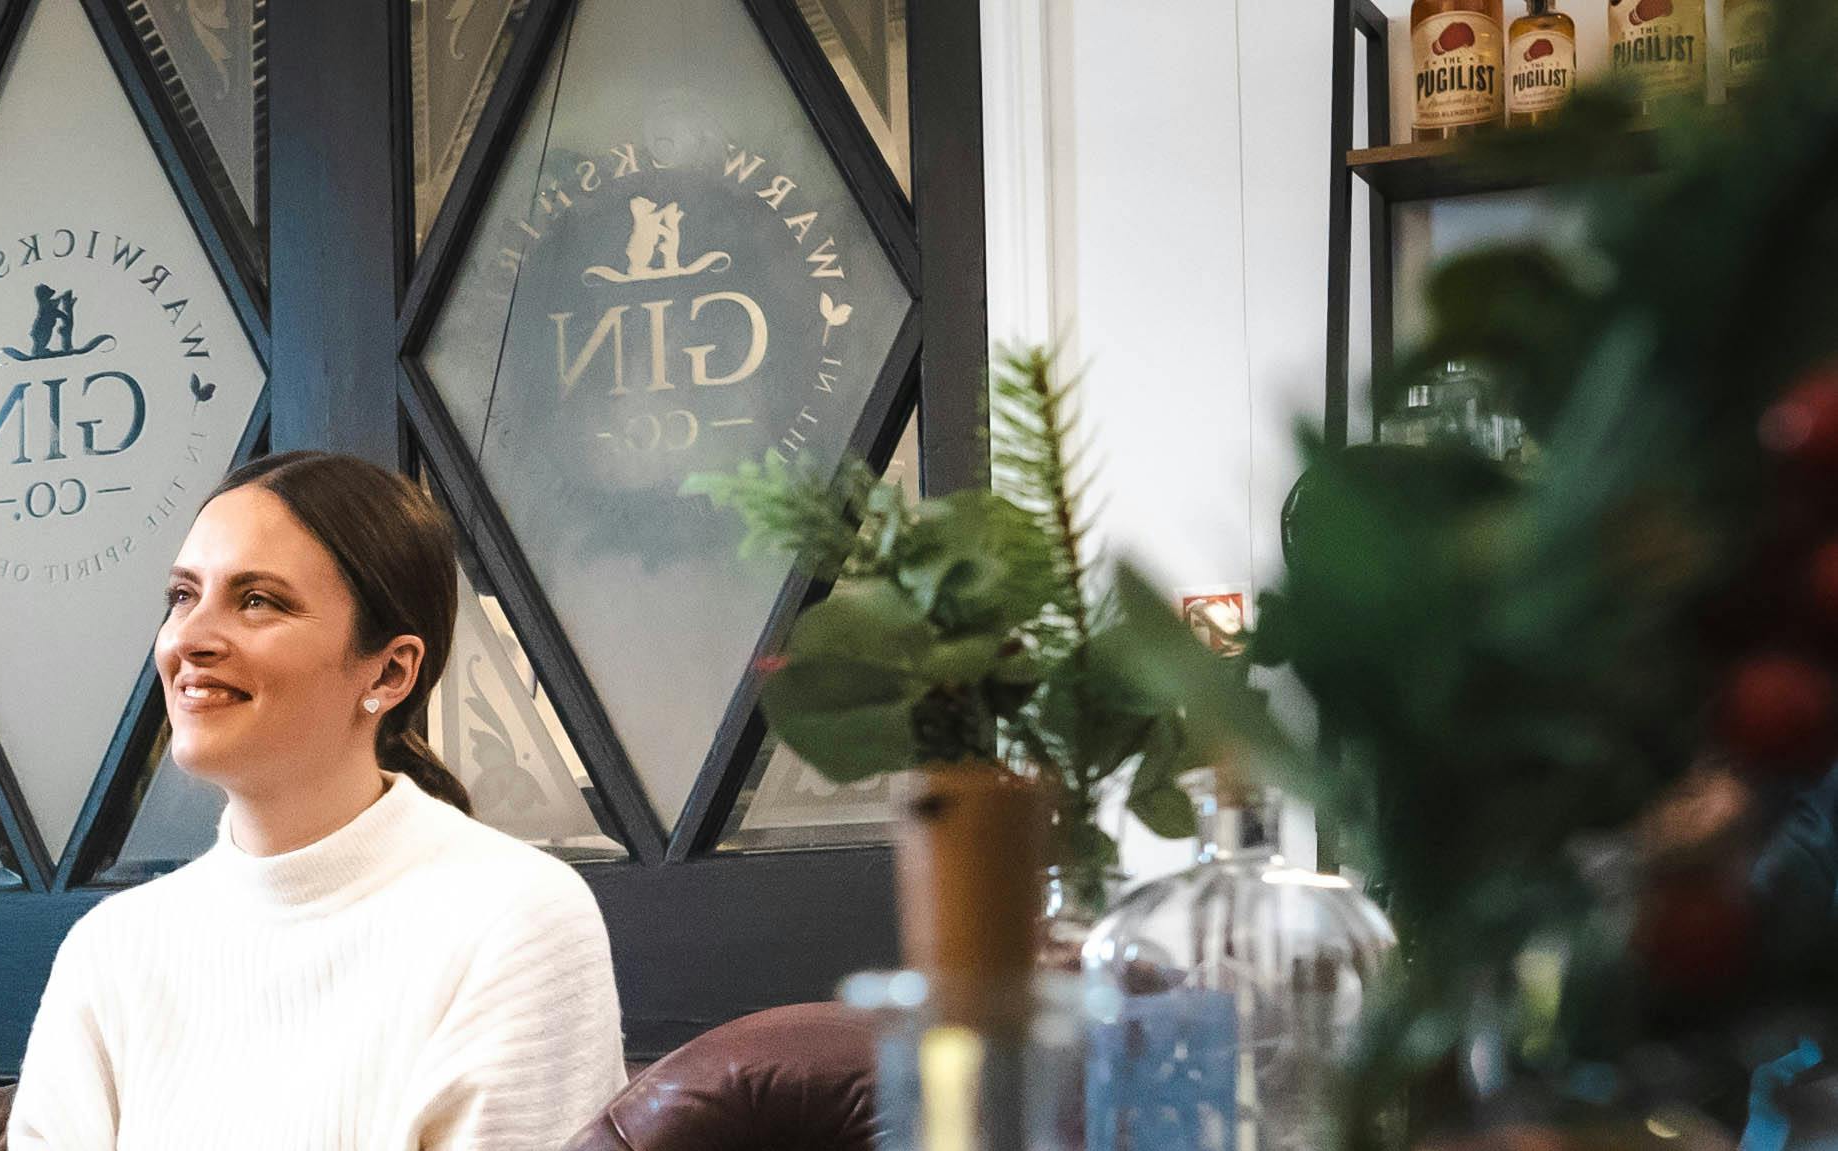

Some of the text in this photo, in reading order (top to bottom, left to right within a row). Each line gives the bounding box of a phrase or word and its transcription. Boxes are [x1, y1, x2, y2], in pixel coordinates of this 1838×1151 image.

[1443, 56, 1461, 65] THE
[1417, 65, 1495, 102] PUGILIST
[1513, 69, 1567, 94] PUGILIST
